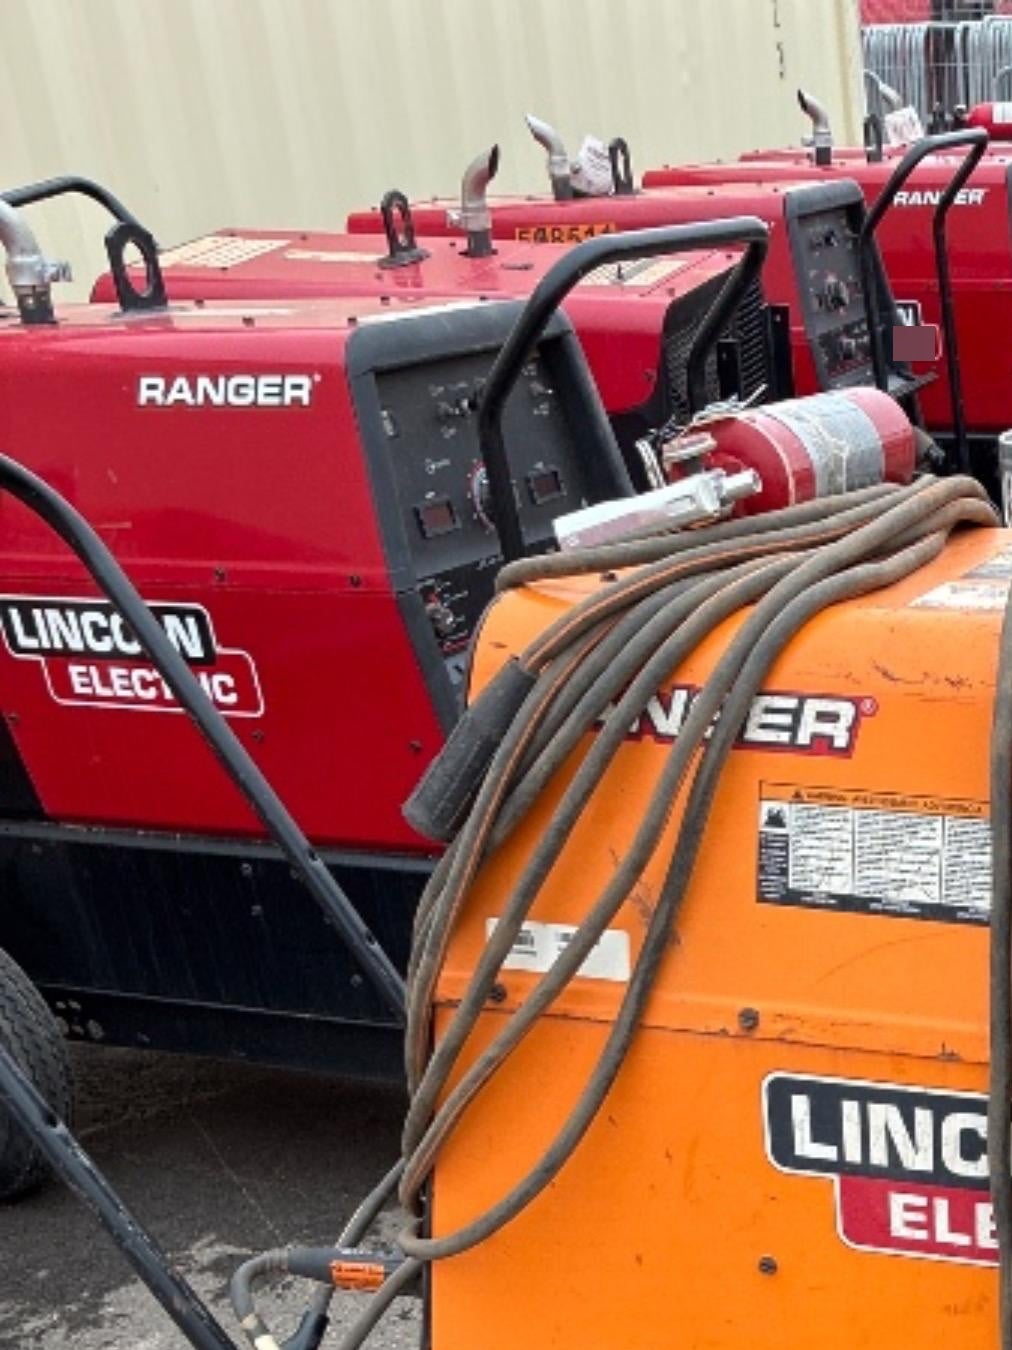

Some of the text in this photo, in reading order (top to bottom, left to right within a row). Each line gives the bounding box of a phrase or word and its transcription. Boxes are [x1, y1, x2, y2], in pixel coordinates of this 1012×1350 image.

[893, 189, 988, 206] RANER
[138, 375, 311, 406] RANGER
[8, 607, 204, 659] LINCON
[68, 664, 238, 704] ELECTIC
